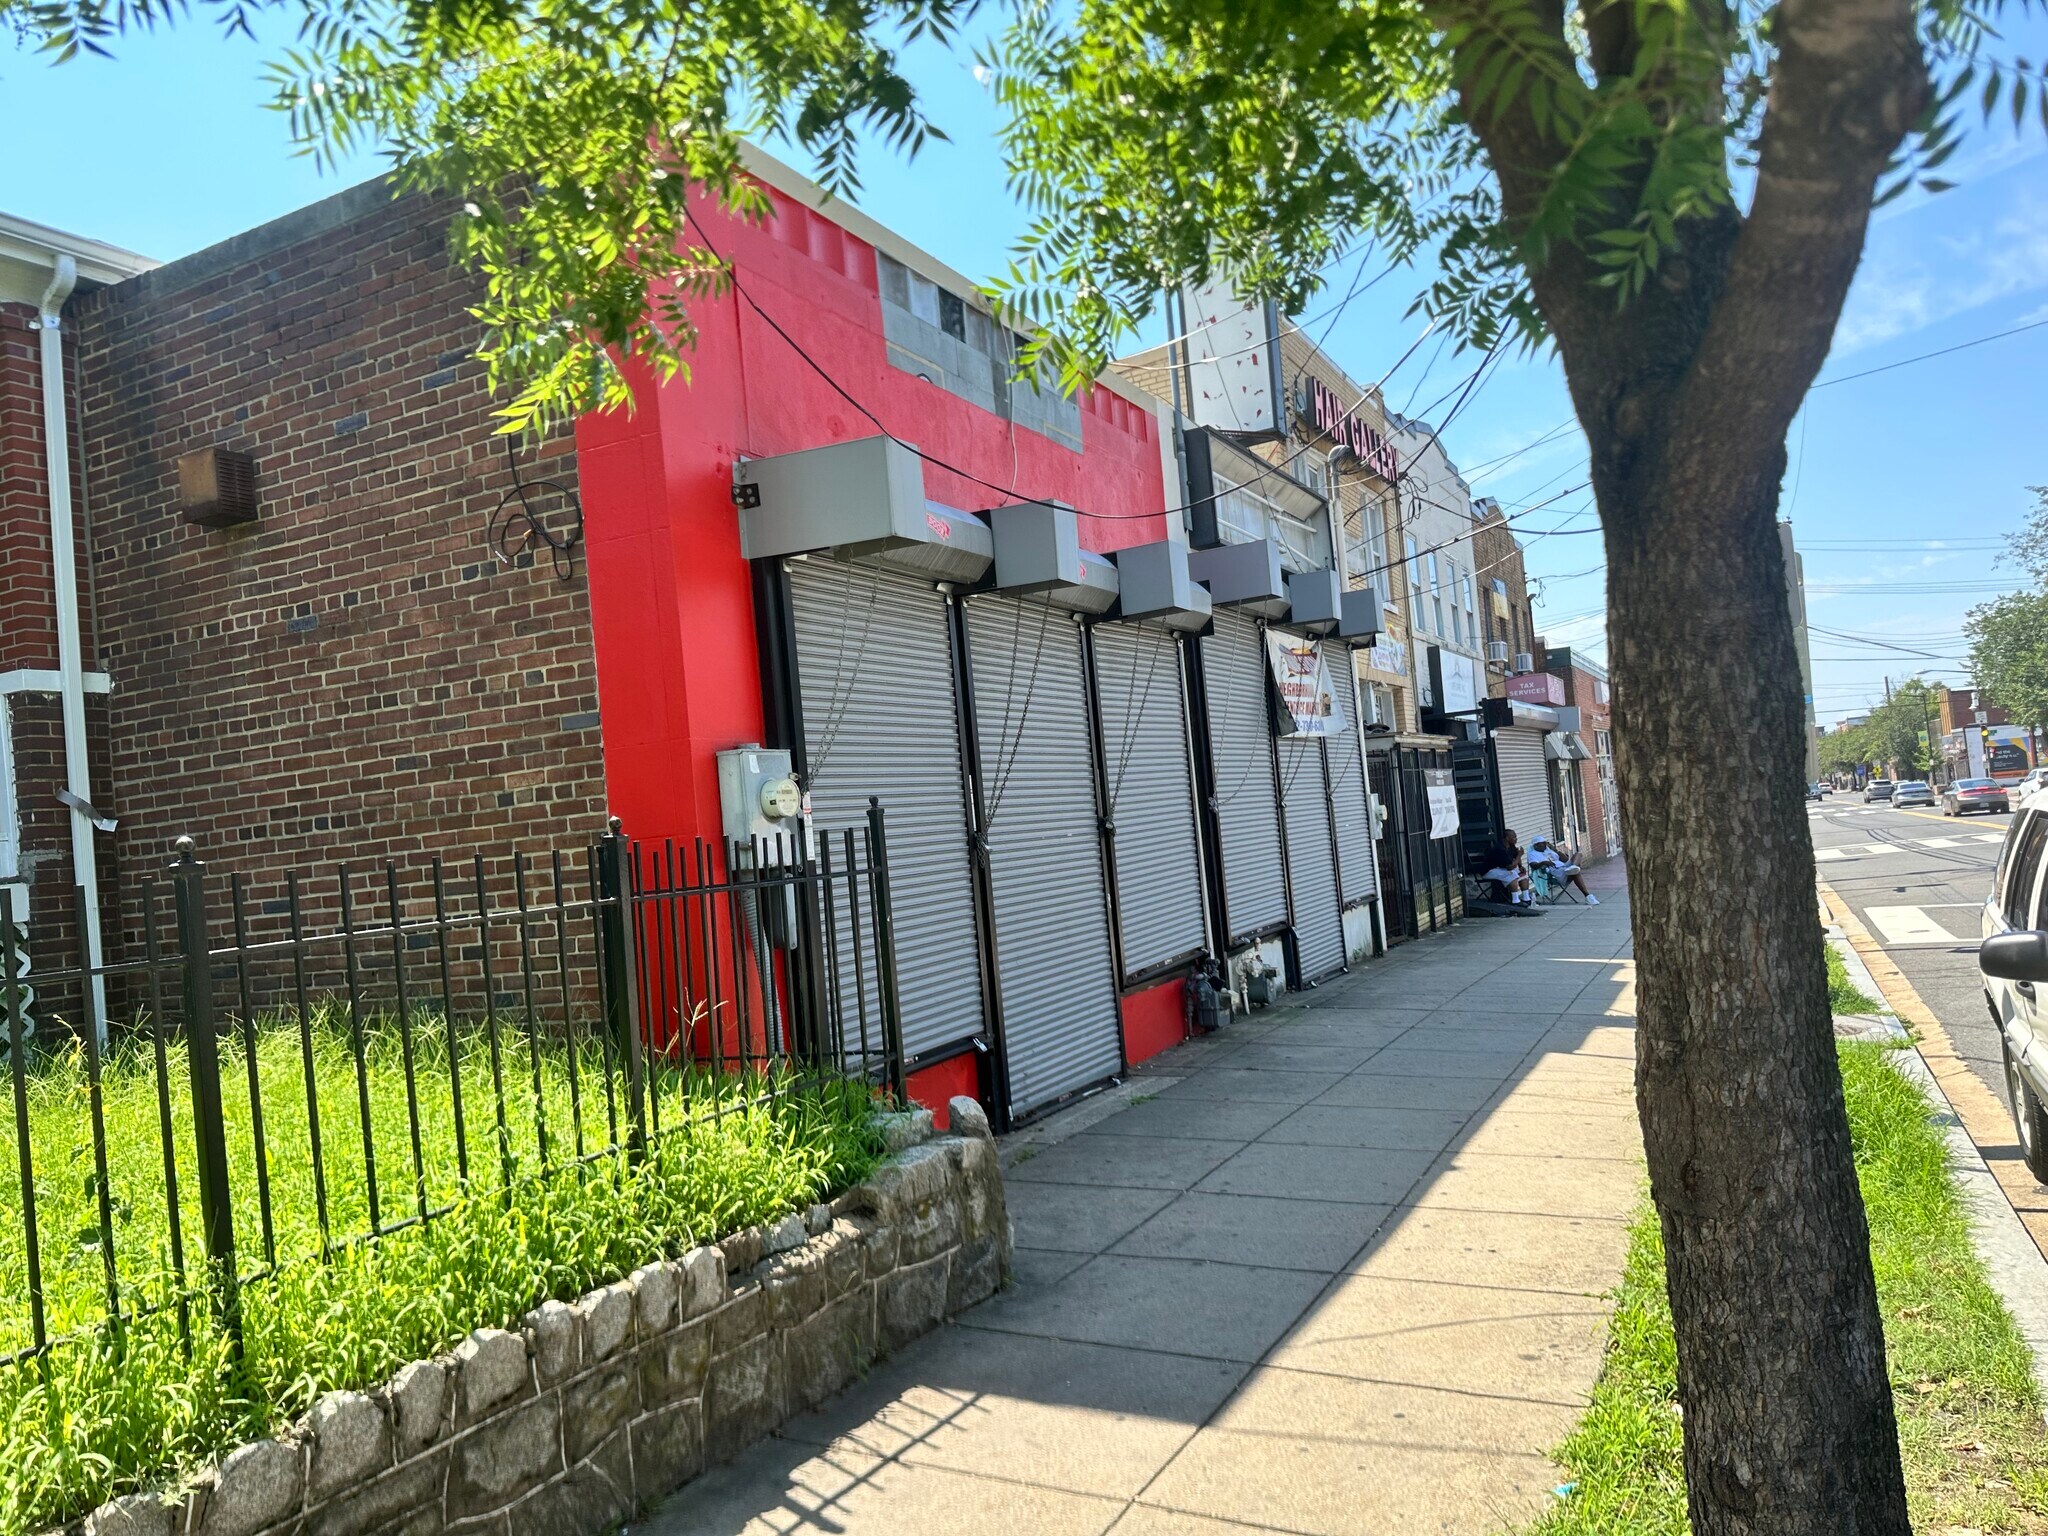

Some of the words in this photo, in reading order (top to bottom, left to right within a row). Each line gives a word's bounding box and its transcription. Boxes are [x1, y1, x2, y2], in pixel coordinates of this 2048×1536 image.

[1313, 377, 1348, 446] HAIR
[1350, 411, 1399, 482] GALLERY
[1508, 688, 1546, 696] SERVICES
